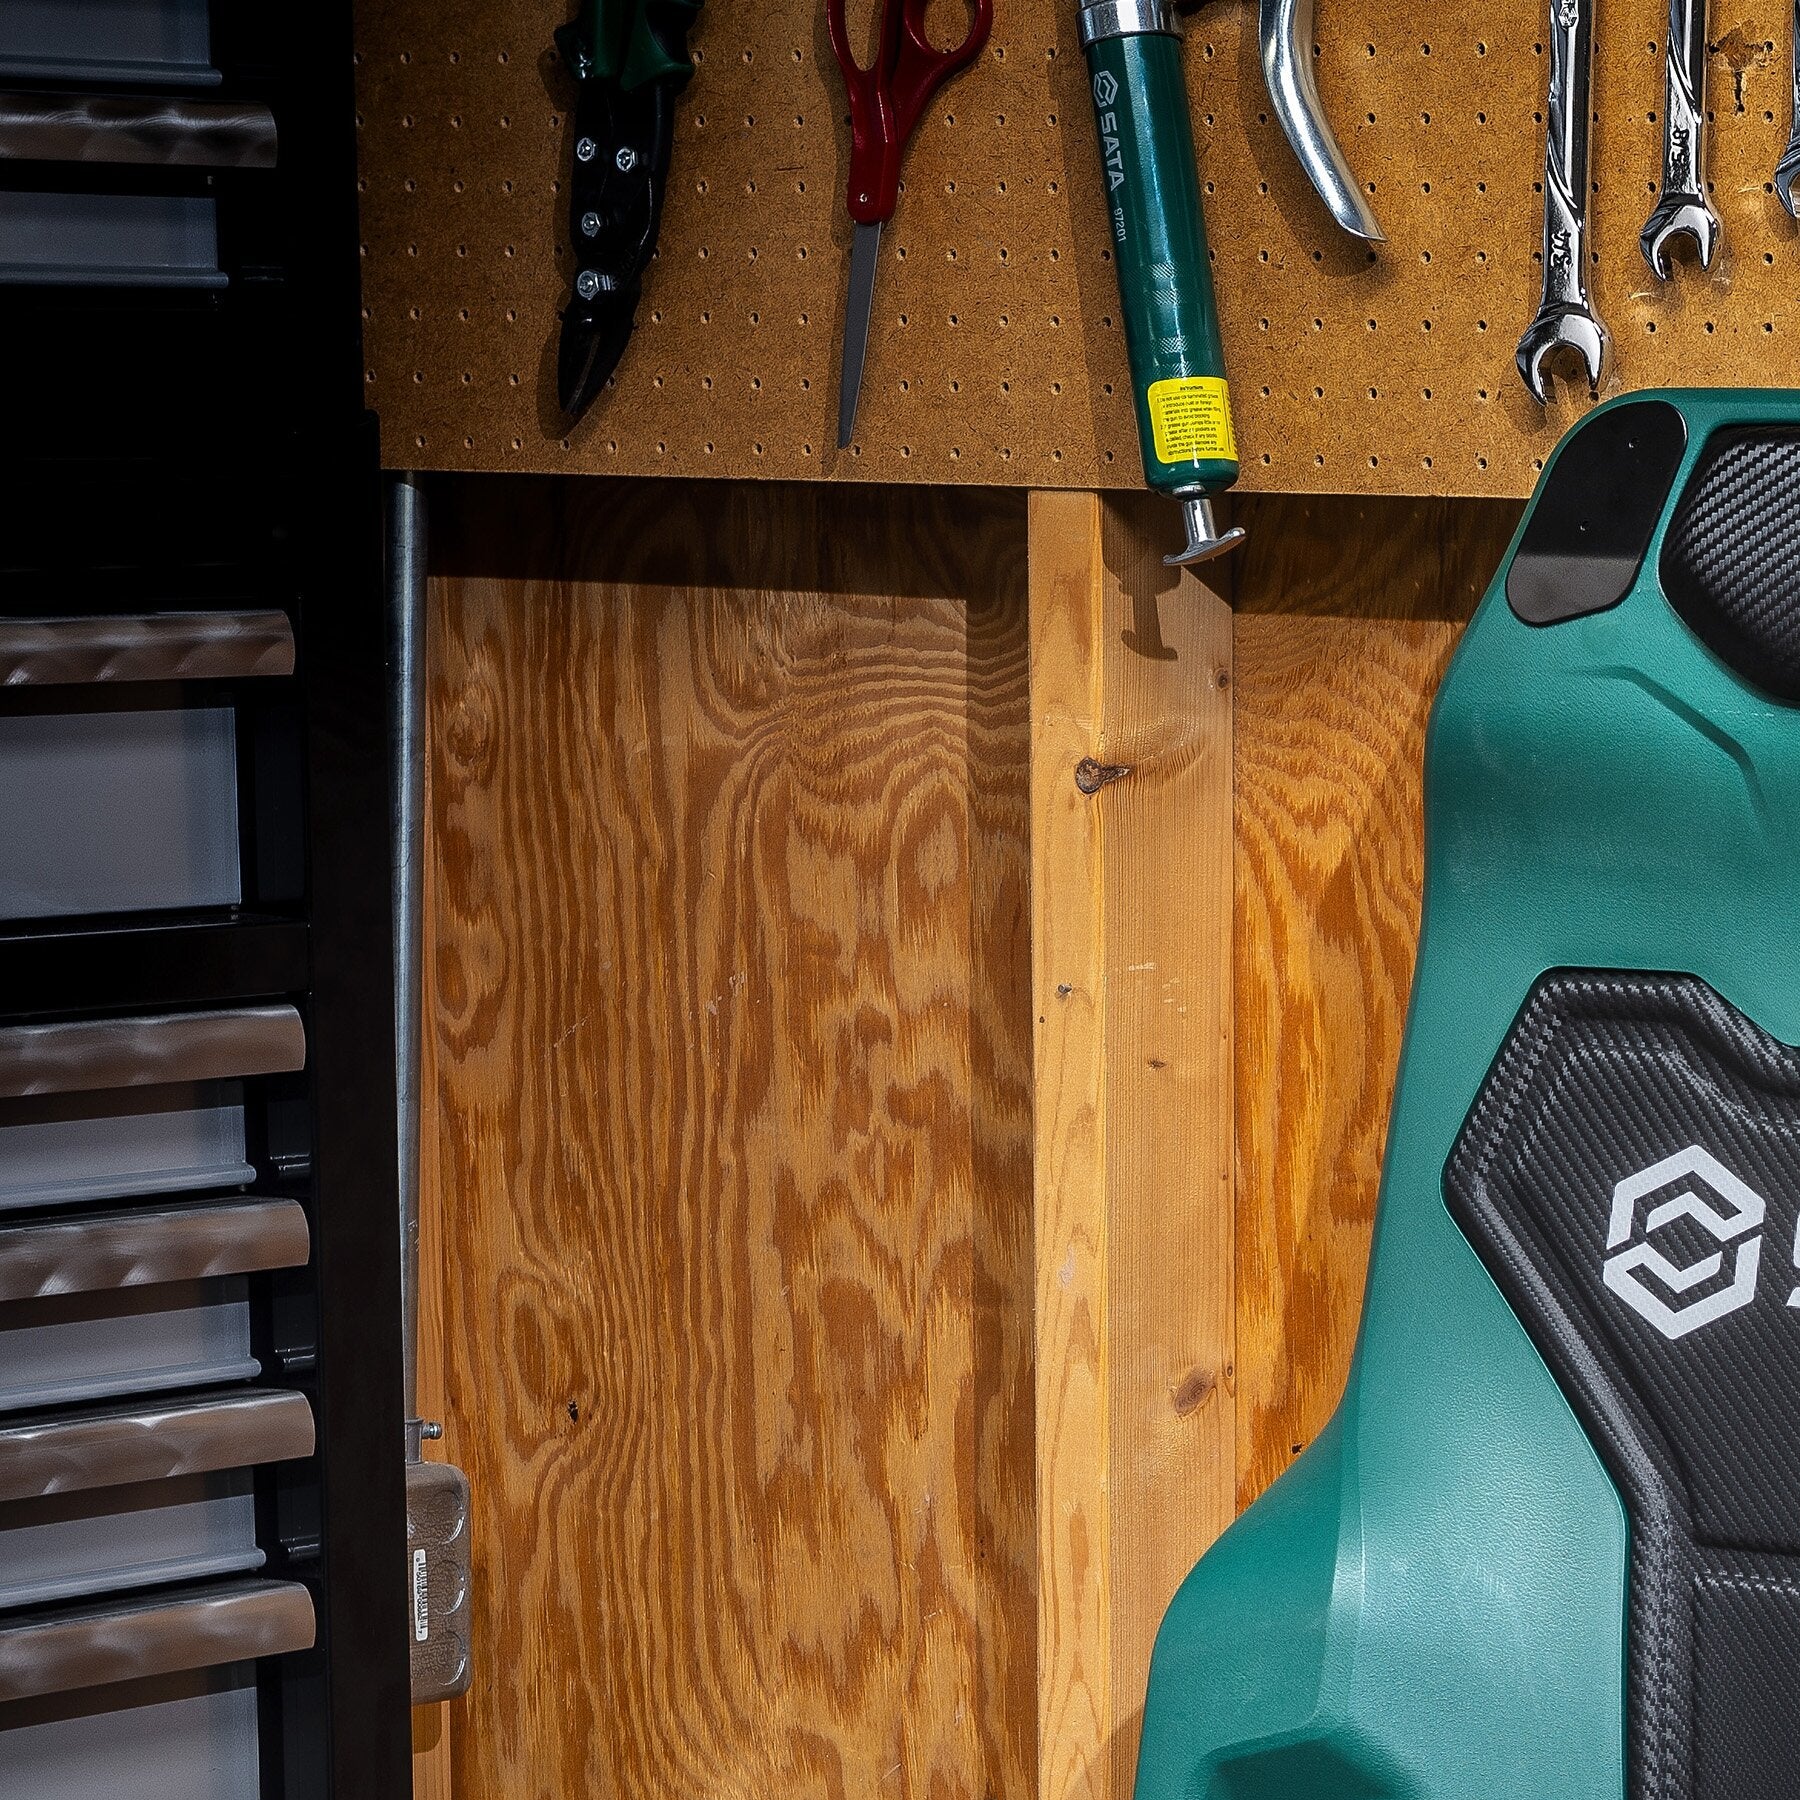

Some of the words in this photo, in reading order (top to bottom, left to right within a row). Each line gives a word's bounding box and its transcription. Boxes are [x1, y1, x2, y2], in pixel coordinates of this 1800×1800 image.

[1672, 126, 1690, 164] 5/8
[1100, 112, 1125, 191] SATA
[1114, 207, 1127, 242] 97201
[1553, 229, 1573, 266] 3/4
